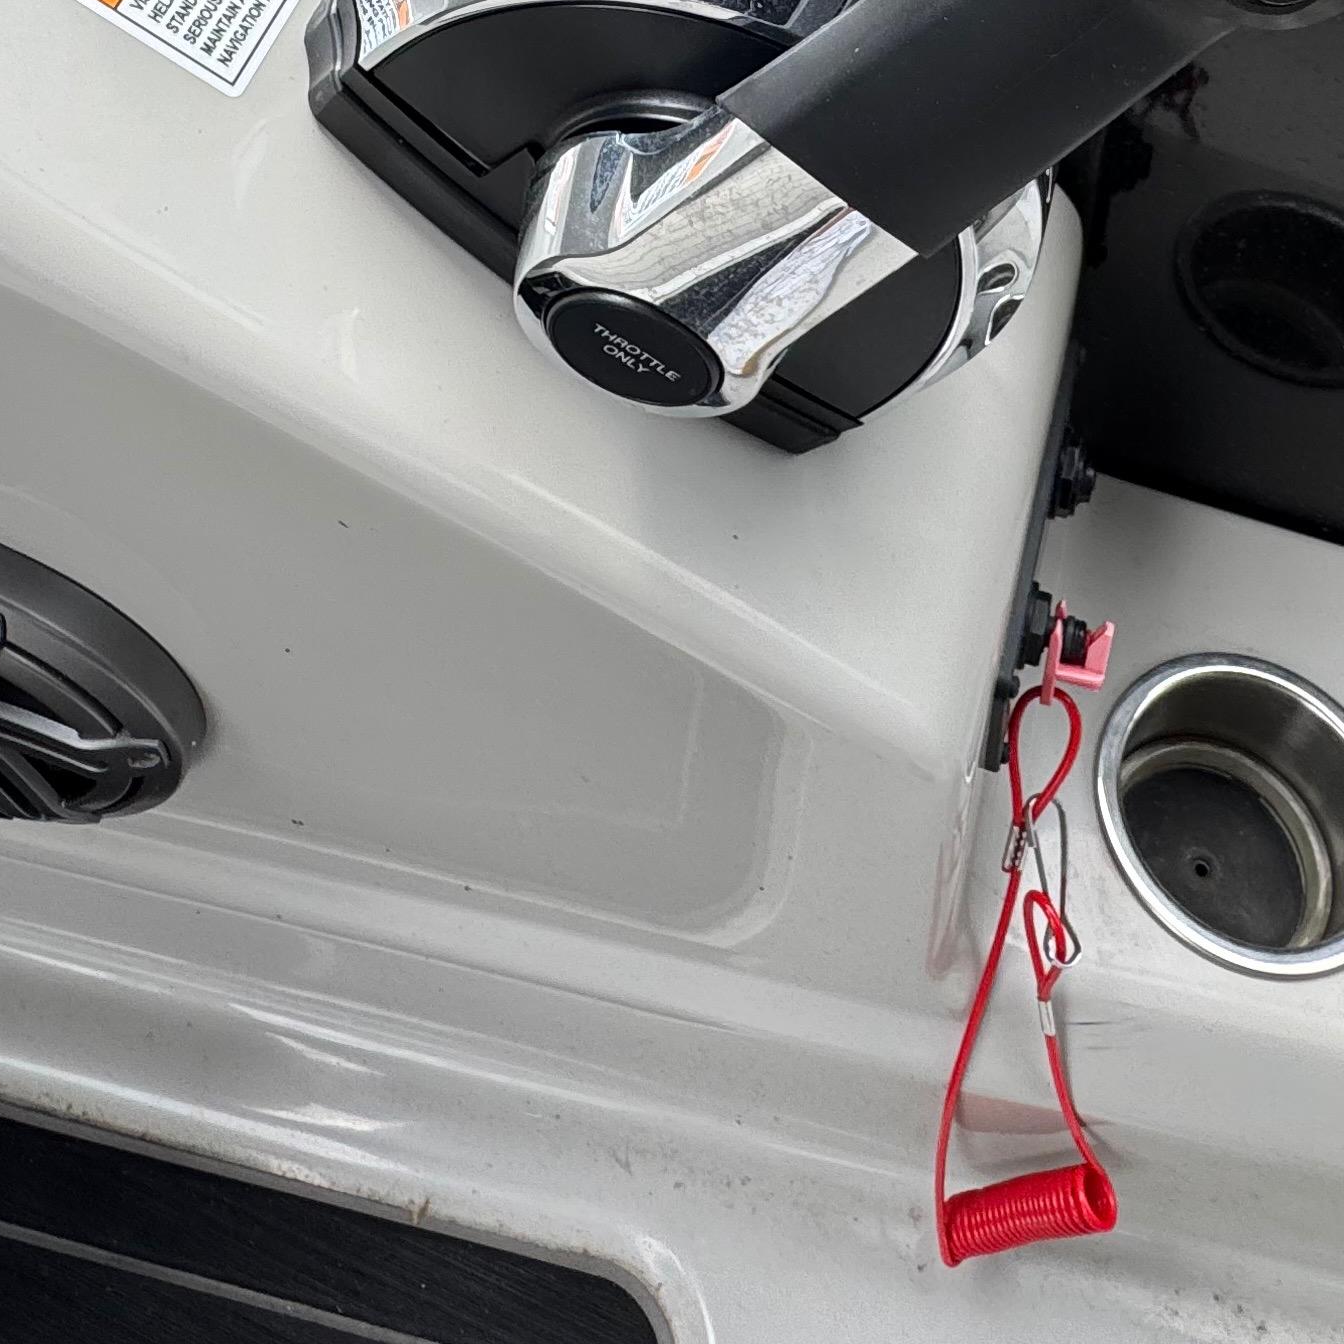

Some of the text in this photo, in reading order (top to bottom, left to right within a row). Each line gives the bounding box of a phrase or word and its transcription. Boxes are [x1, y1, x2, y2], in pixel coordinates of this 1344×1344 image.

[200, 1, 242, 56] MAINTAIN
[217, 0, 266, 67] NAVIGATION
[593, 323, 680, 382] THROTTLE
[603, 345, 651, 374] ONLY
